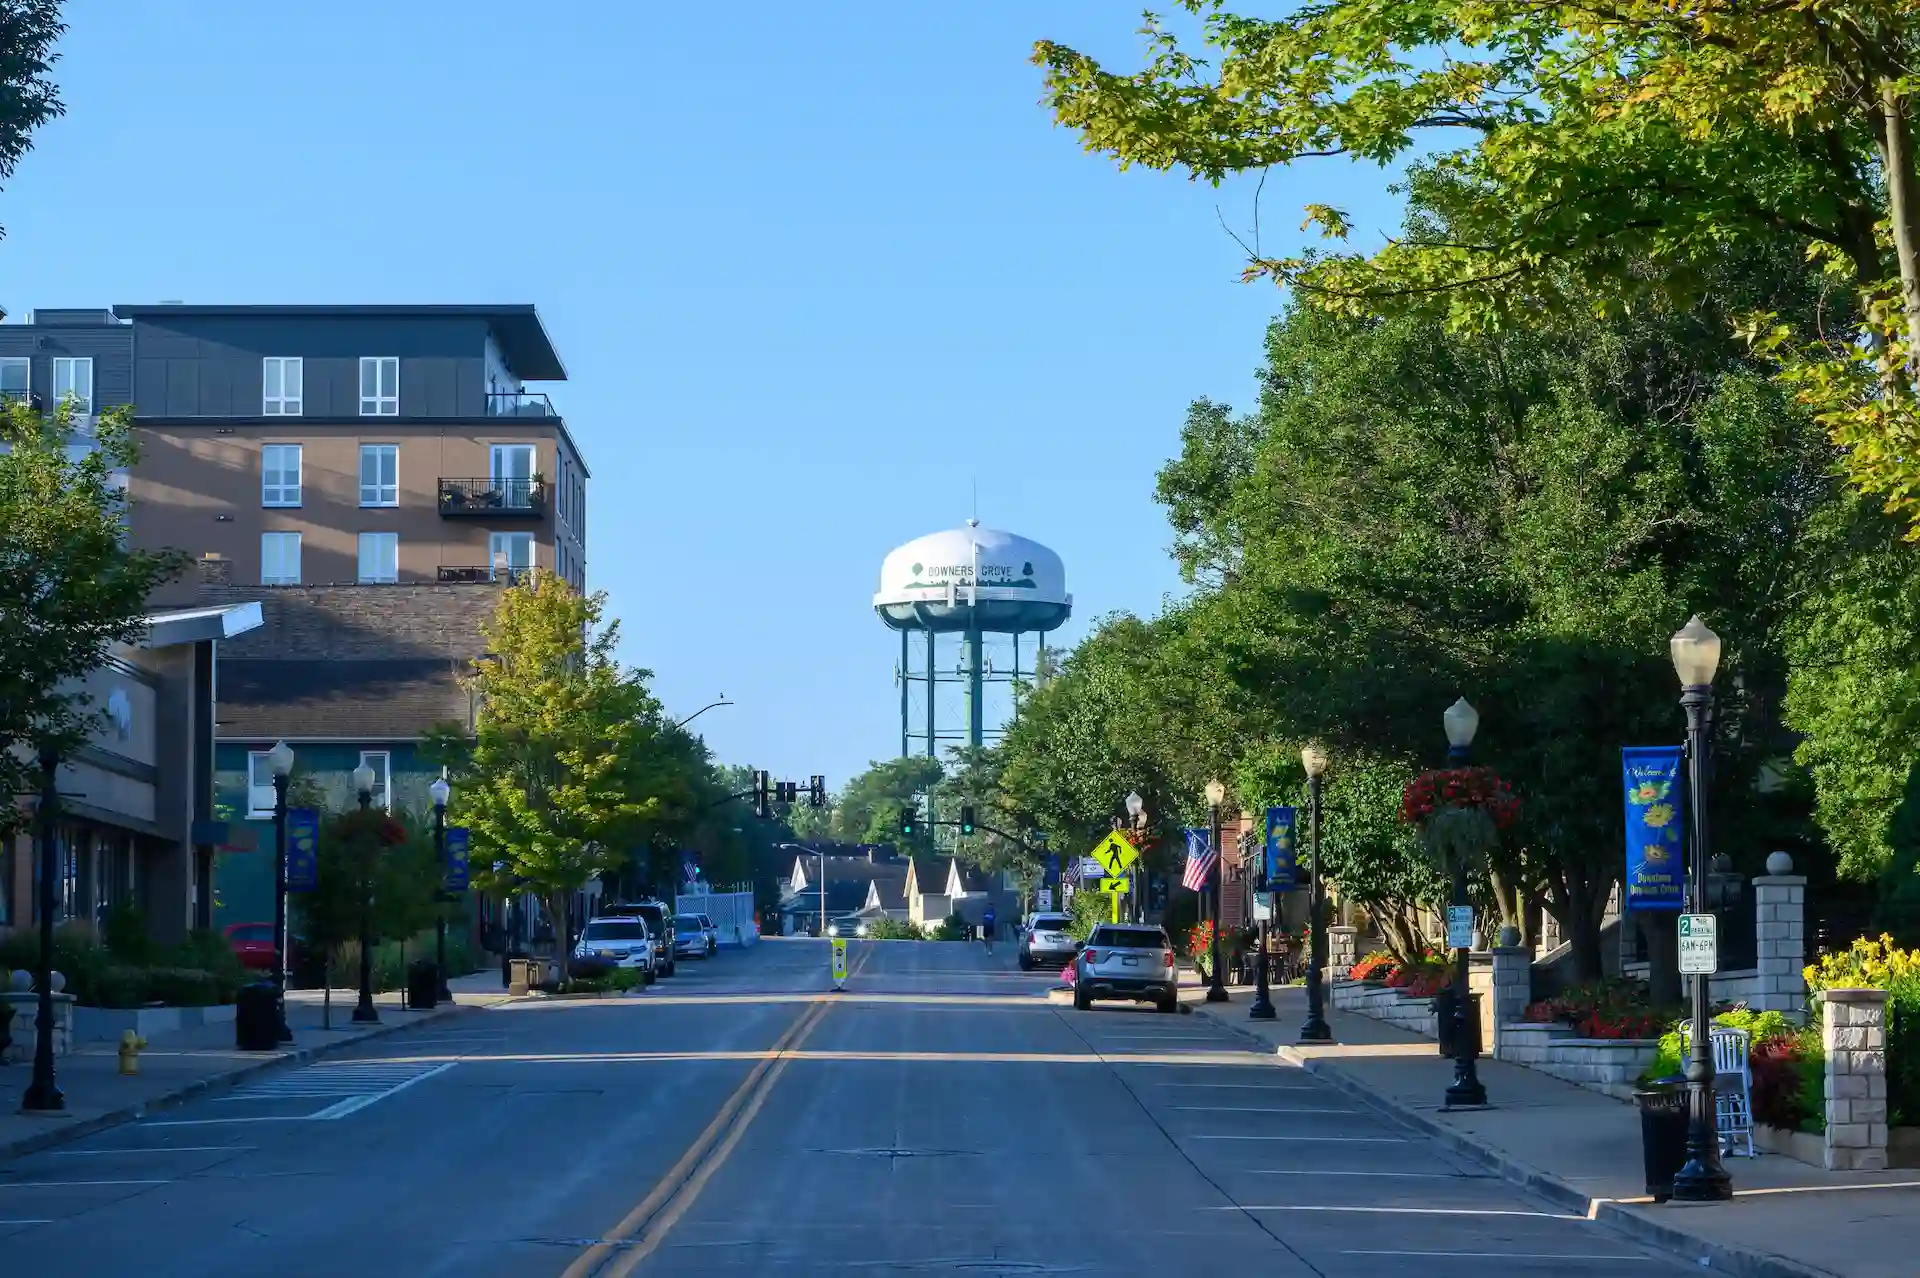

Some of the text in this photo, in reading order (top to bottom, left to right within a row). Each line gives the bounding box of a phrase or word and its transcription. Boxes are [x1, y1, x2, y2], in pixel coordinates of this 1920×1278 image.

[928, 566, 1013, 577] DOWNERS GROVE
[1626, 765, 1665, 778] Welcom
[1637, 873, 1672, 884] Downto
[1630, 884, 1679, 895] Down Gro
[1681, 920, 1689, 933] 2
[1681, 940, 1713, 951] 6AM-6PM
